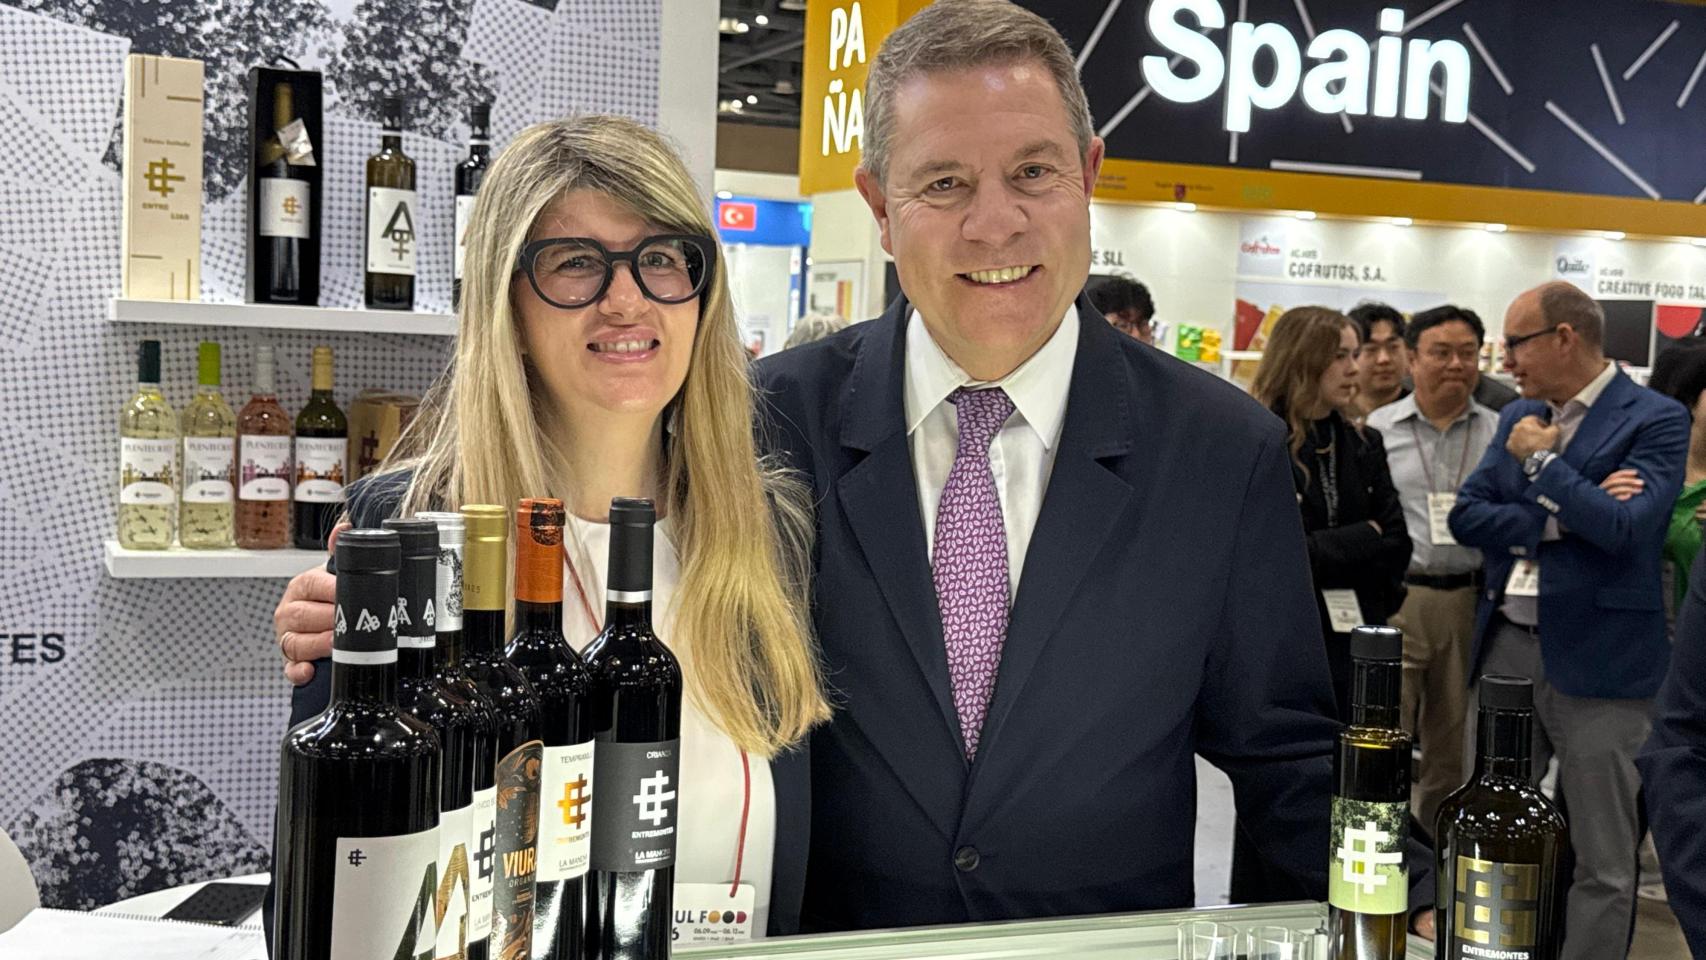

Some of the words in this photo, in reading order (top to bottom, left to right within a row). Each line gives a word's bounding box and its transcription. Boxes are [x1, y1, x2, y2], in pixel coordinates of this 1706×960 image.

[828, 2, 866, 71] PA
[1140, 0, 1472, 132] Spain
[1362, 267, 1387, 281] S.A.
[1598, 281, 1651, 296] CREATIVE
[1655, 283, 1684, 299] FOOD
[699, 910, 748, 924] FOOD
[1462, 944, 1530, 960] ENTREMONTES
